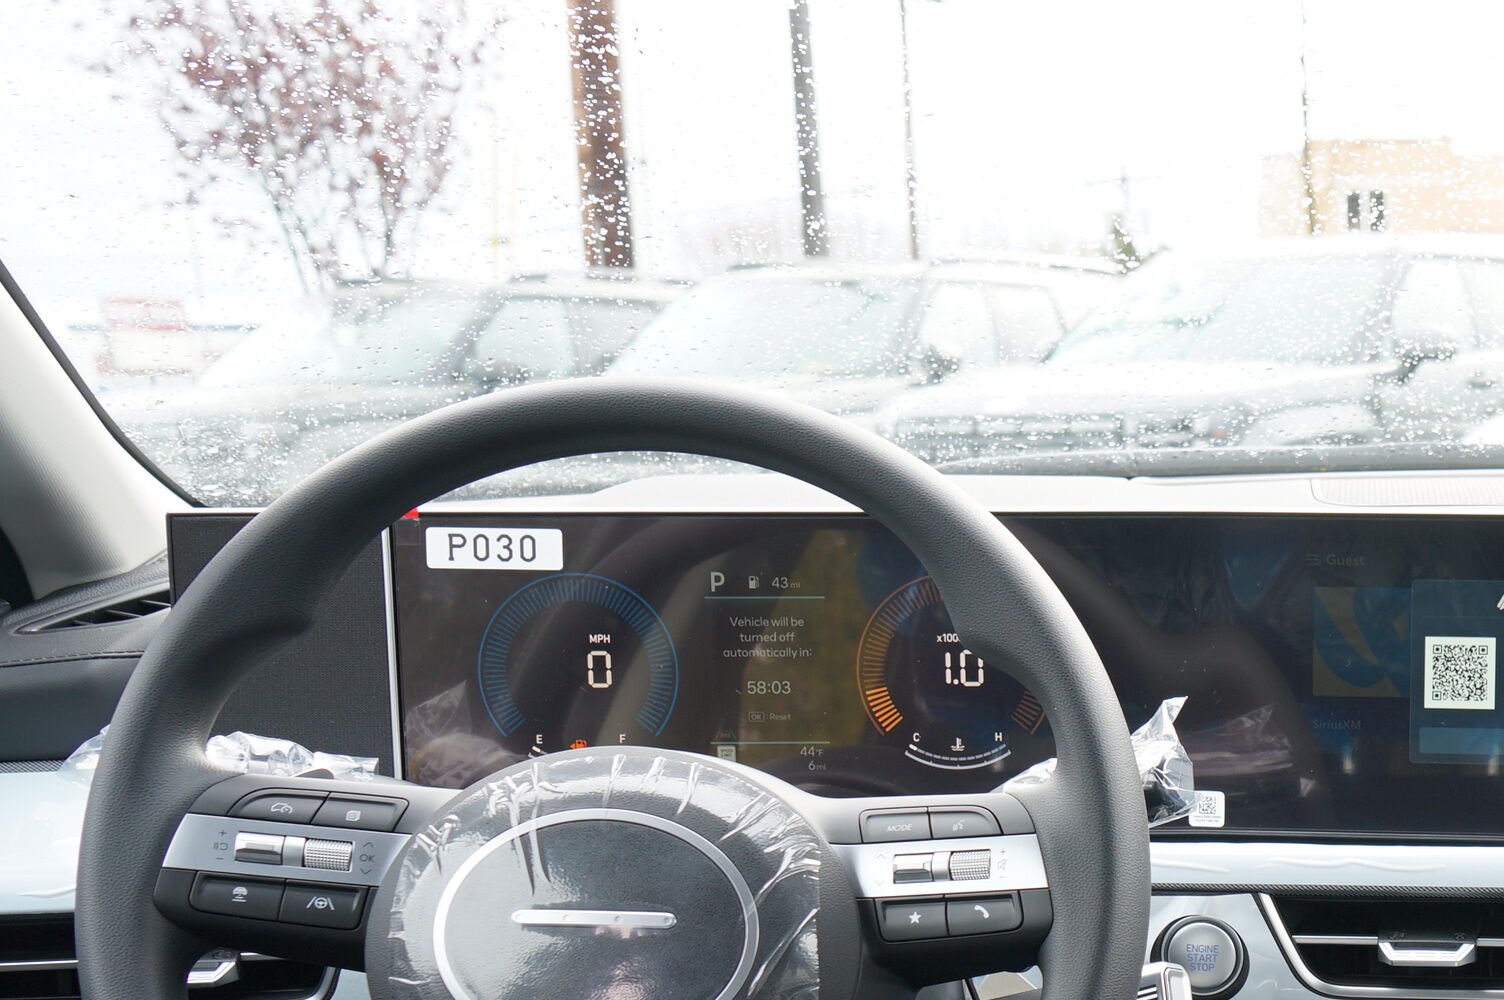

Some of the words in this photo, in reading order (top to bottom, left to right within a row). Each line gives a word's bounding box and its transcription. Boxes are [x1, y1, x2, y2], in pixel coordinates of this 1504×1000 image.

[448, 533, 537, 563] P030
[1326, 553, 1367, 566] Guest
[710, 572, 725, 592] P
[771, 576, 789, 589] 43
[729, 616, 769, 627] Vehicle
[771, 616, 789, 627] will
[790, 616, 805, 627] be
[589, 634, 611, 644] MPH
[740, 632, 777, 642] turned
[779, 632, 795, 642] off
[936, 633, 960, 643] x100
[723, 648, 797, 660] automatically
[799, 648, 813, 658] in:
[587, 651, 613, 689] 0
[945, 649, 984, 687] 1.0
[747, 681, 791, 695] 58:03
[536, 734, 543, 744] E
[619, 734, 626, 744] F
[912, 732, 921, 743] C
[994, 732, 1003, 742] H
[808, 761, 816, 771] 6
[816, 763, 826, 771] mi
[887, 823, 913, 833] MODE
[360, 854, 375, 862] OK
[1186, 944, 1220, 954] ENGINE
[1186, 954, 1218, 963] START
[1190, 962, 1215, 972] STOP
